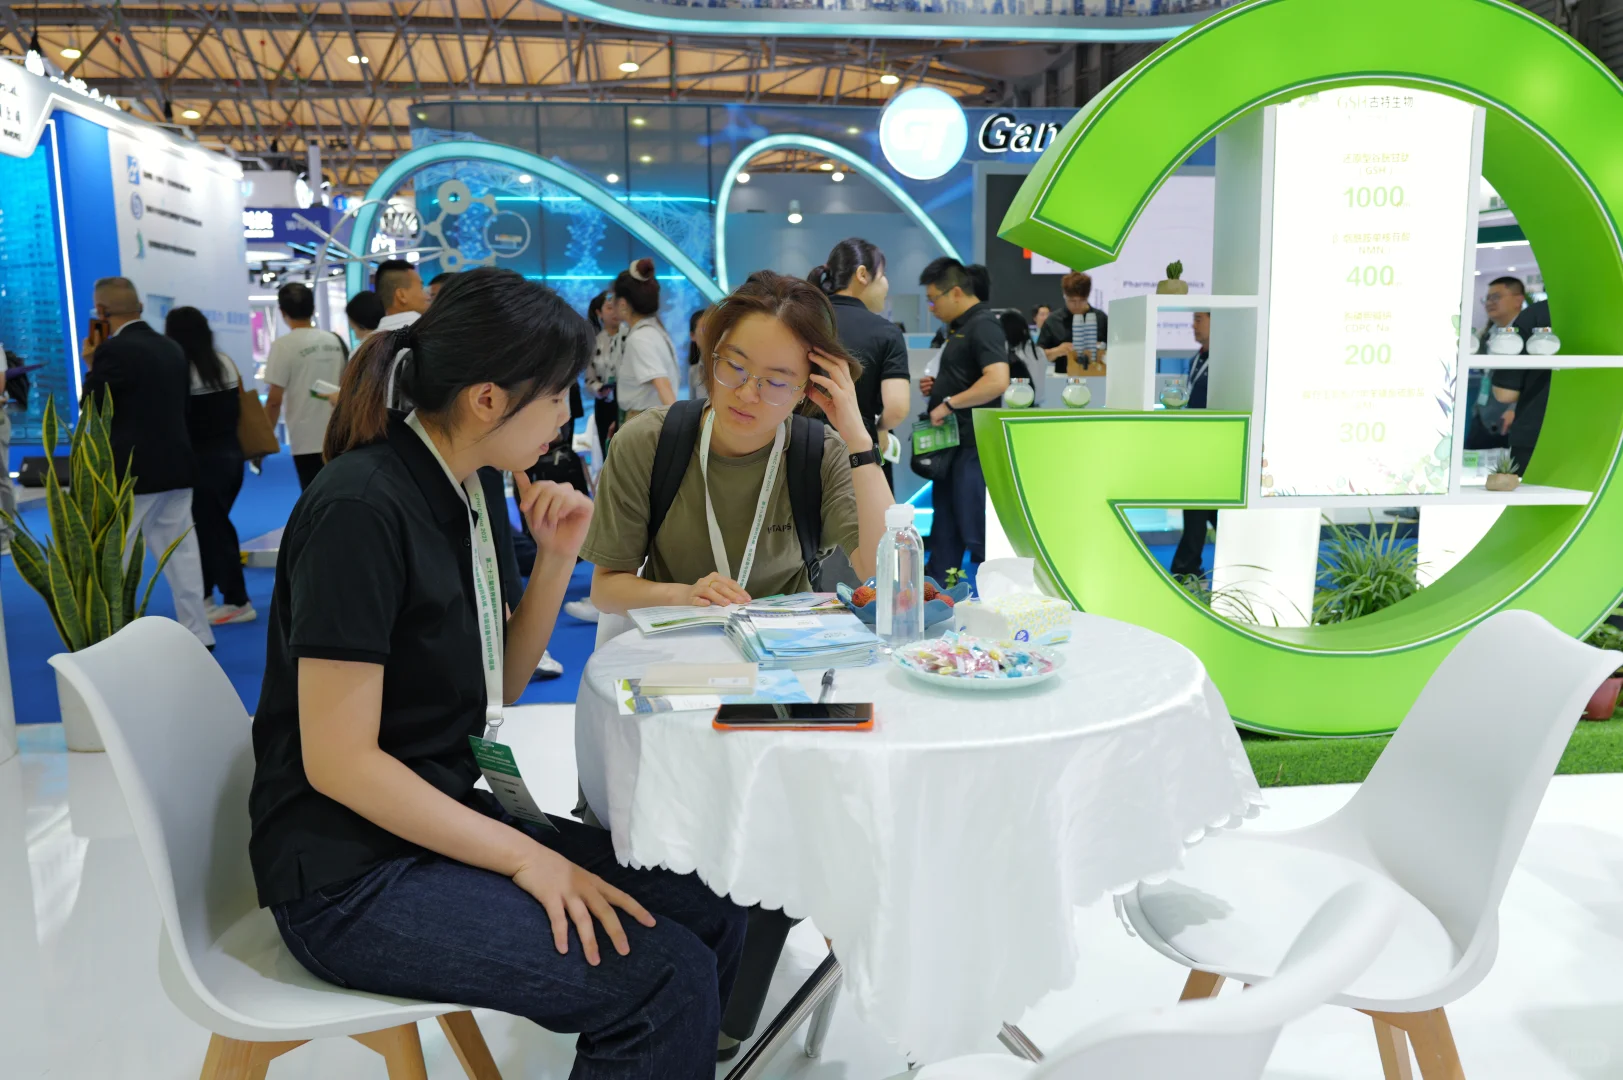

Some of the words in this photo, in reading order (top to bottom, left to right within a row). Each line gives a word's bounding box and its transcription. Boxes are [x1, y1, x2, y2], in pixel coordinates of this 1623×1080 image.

[1342, 185, 1405, 208] 1000
[1346, 265, 1395, 287] 400
[1344, 343, 1392, 365] 200
[1340, 421, 1386, 443] 300
